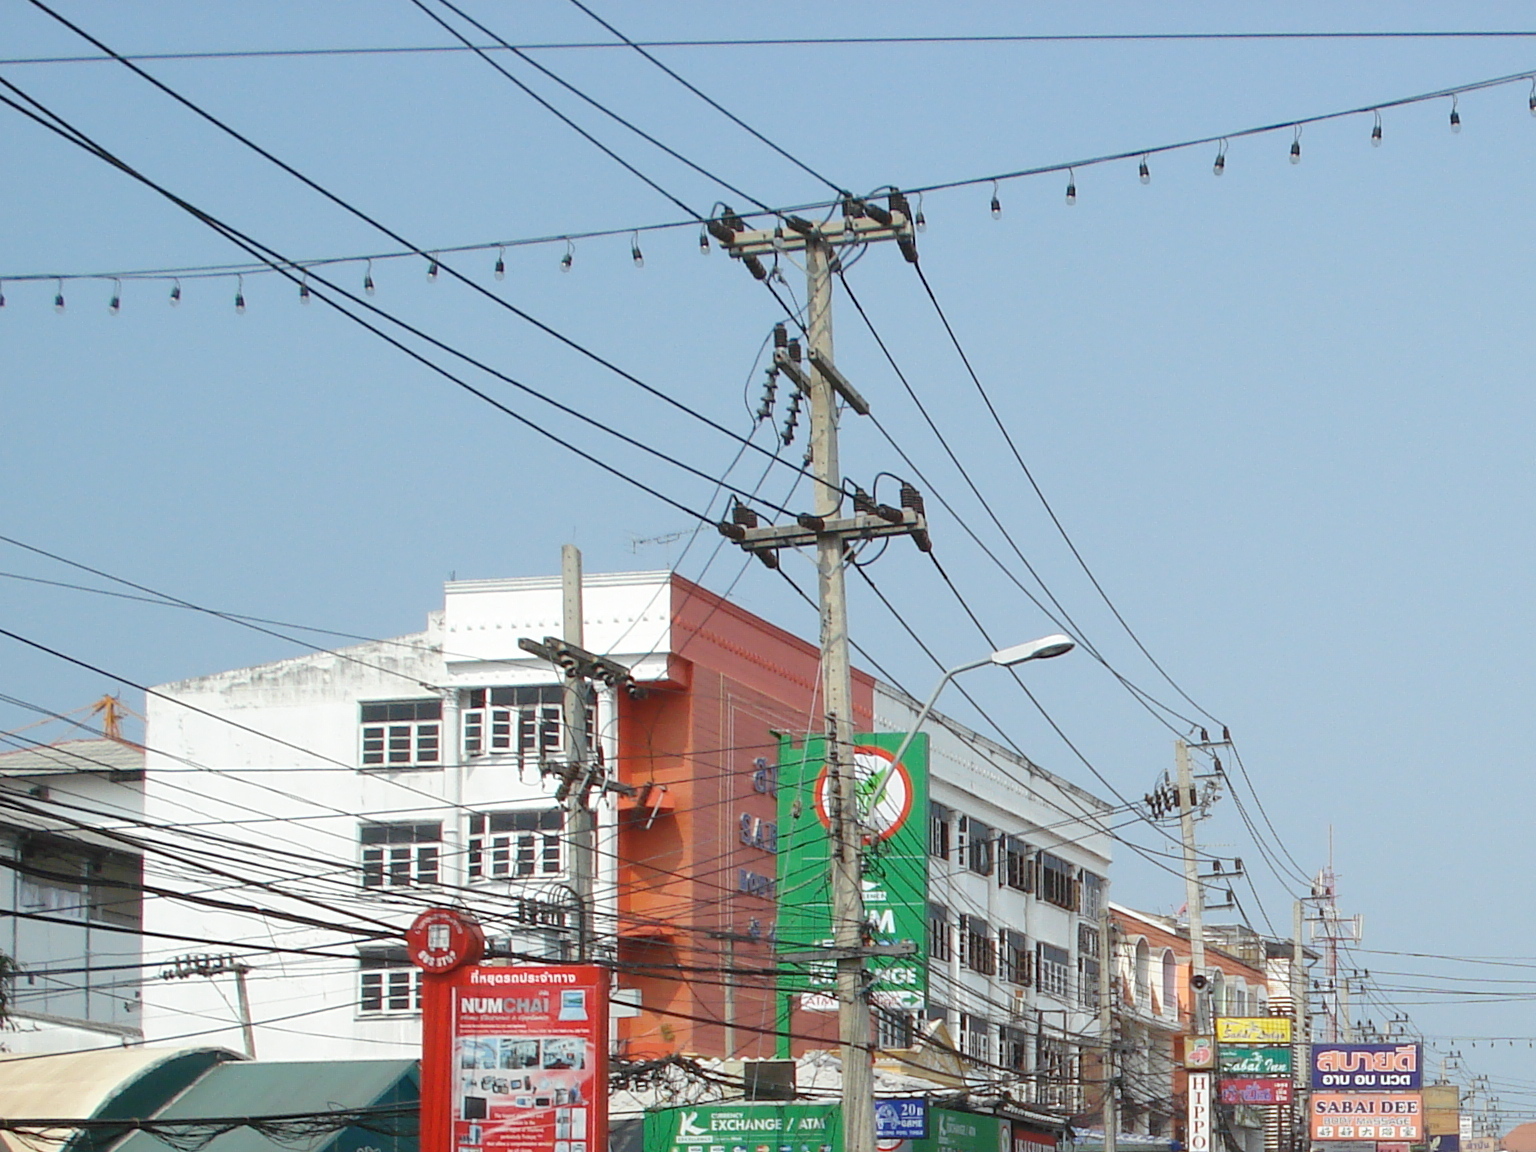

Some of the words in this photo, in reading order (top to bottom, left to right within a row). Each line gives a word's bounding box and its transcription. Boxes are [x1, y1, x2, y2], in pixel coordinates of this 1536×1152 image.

[418, 950, 435, 967] BUS
[470, 969, 576, 986] ที่หยุดรถประจำทาง
[460, 997, 550, 1014] NUMCHAI
[1264, 1058, 1287, 1072] Inn
[1316, 1044, 1417, 1072] สบายดี
[1322, 1074, 1350, 1086] อาบ
[1354, 1074, 1376, 1086] อบ
[1380, 1074, 1411, 1086] นวด
[1192, 1077, 1206, 1150] HIPPO
[1315, 1100, 1375, 1115] SABAI
[1381, 1100, 1418, 1114] DEE
[711, 1118, 783, 1132] EXCHANGE
[798, 1117, 826, 1131] ATM
[901, 1119, 923, 1128] GAME
[1323, 1116, 1353, 1126] BODY
[1356, 1116, 1412, 1127] MASSAGE
